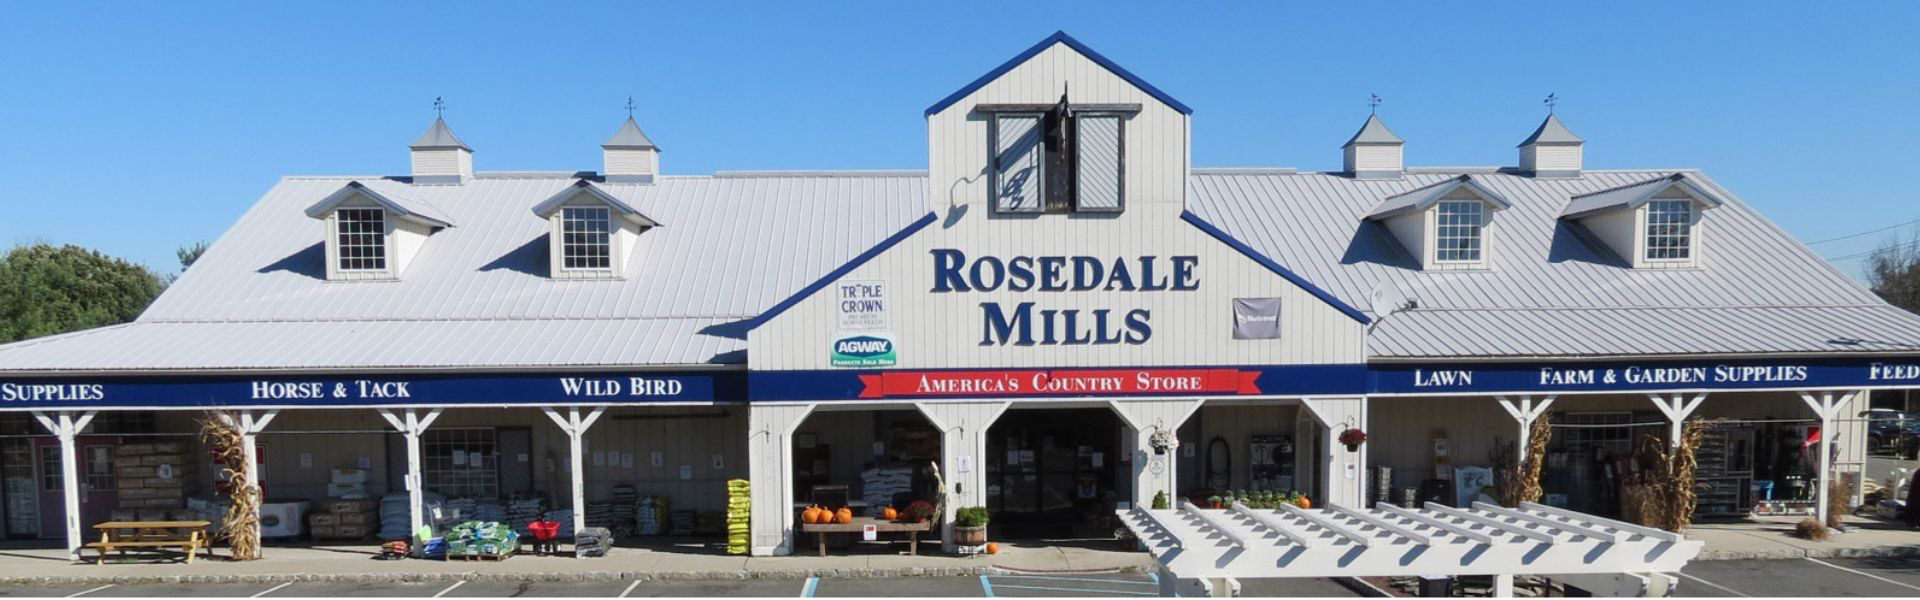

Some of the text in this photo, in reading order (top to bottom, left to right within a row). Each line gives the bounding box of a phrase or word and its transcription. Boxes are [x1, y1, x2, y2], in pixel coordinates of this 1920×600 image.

[929, 248, 1200, 293] ROSEDALE
[841, 284, 882, 298] TRPLE
[841, 300, 883, 313] CROWN
[978, 302, 1152, 346] MILLS
[838, 341, 888, 353] AGWAY
[1414, 369, 1472, 386] LAWN
[1540, 365, 1807, 385] FARM & GARDEN SUPPLIES
[1869, 362, 1920, 380] FEED
[251, 380, 410, 399] HORSE & TACK
[560, 377, 682, 396] WILD BIRD
[916, 372, 1201, 392] AMERICA'S COUNTRY STORE
[2, 383, 104, 401] SUPPLIES
